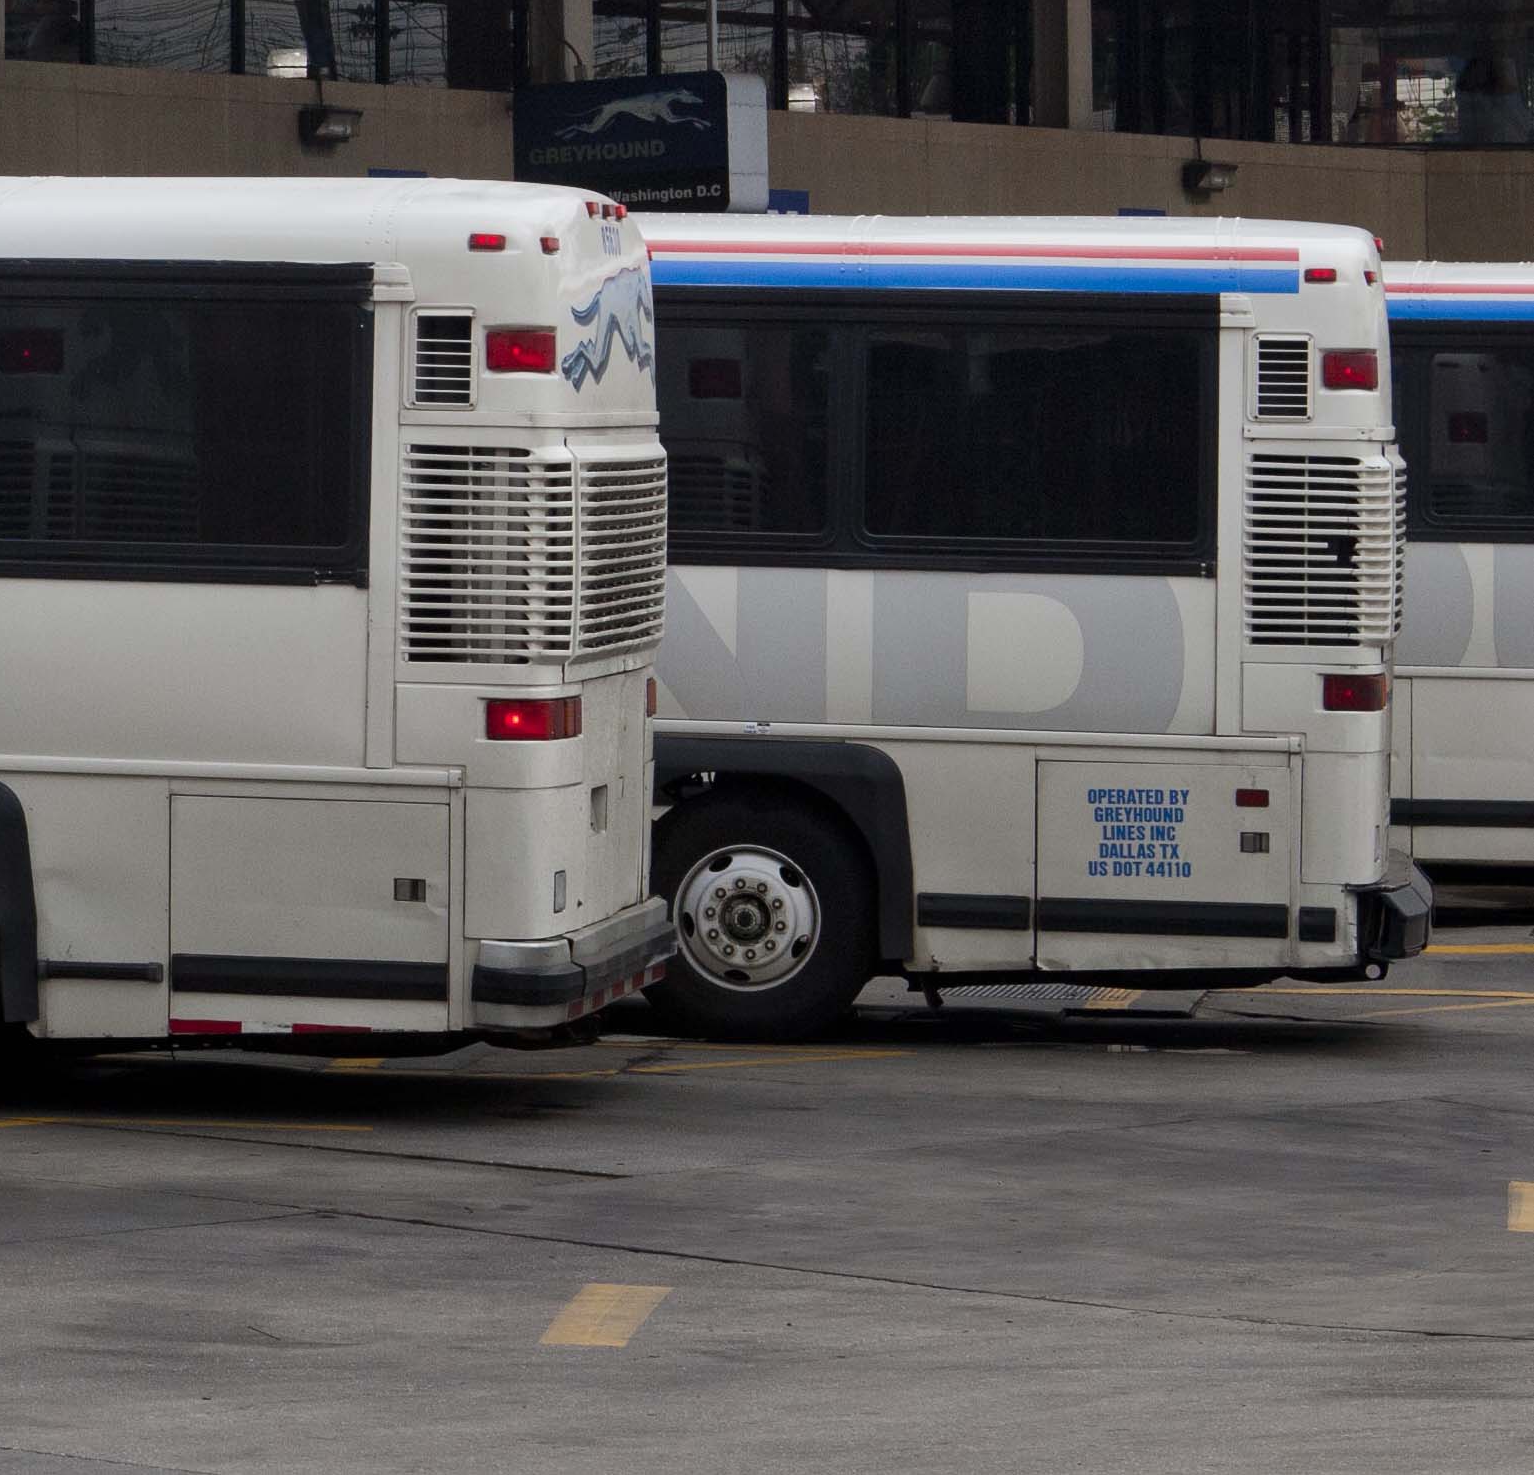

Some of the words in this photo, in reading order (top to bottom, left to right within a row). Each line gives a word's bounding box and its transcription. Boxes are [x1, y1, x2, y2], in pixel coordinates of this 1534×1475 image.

[529, 139, 666, 165] GREYHOUND
[609, 185, 693, 204] Washington
[1087, 788, 1164, 805] OPERATED
[1169, 789, 1190, 805] BY
[1094, 806, 1184, 823] GREYHOUND
[1102, 825, 1146, 841] LINES
[1150, 826, 1176, 841] INC
[1099, 843, 1156, 859] DALLAS
[1158, 844, 1180, 860] TX
[1088, 860, 1108, 876] US
[1113, 861, 1143, 877] DOT
[1145, 861, 1192, 878] 44110
